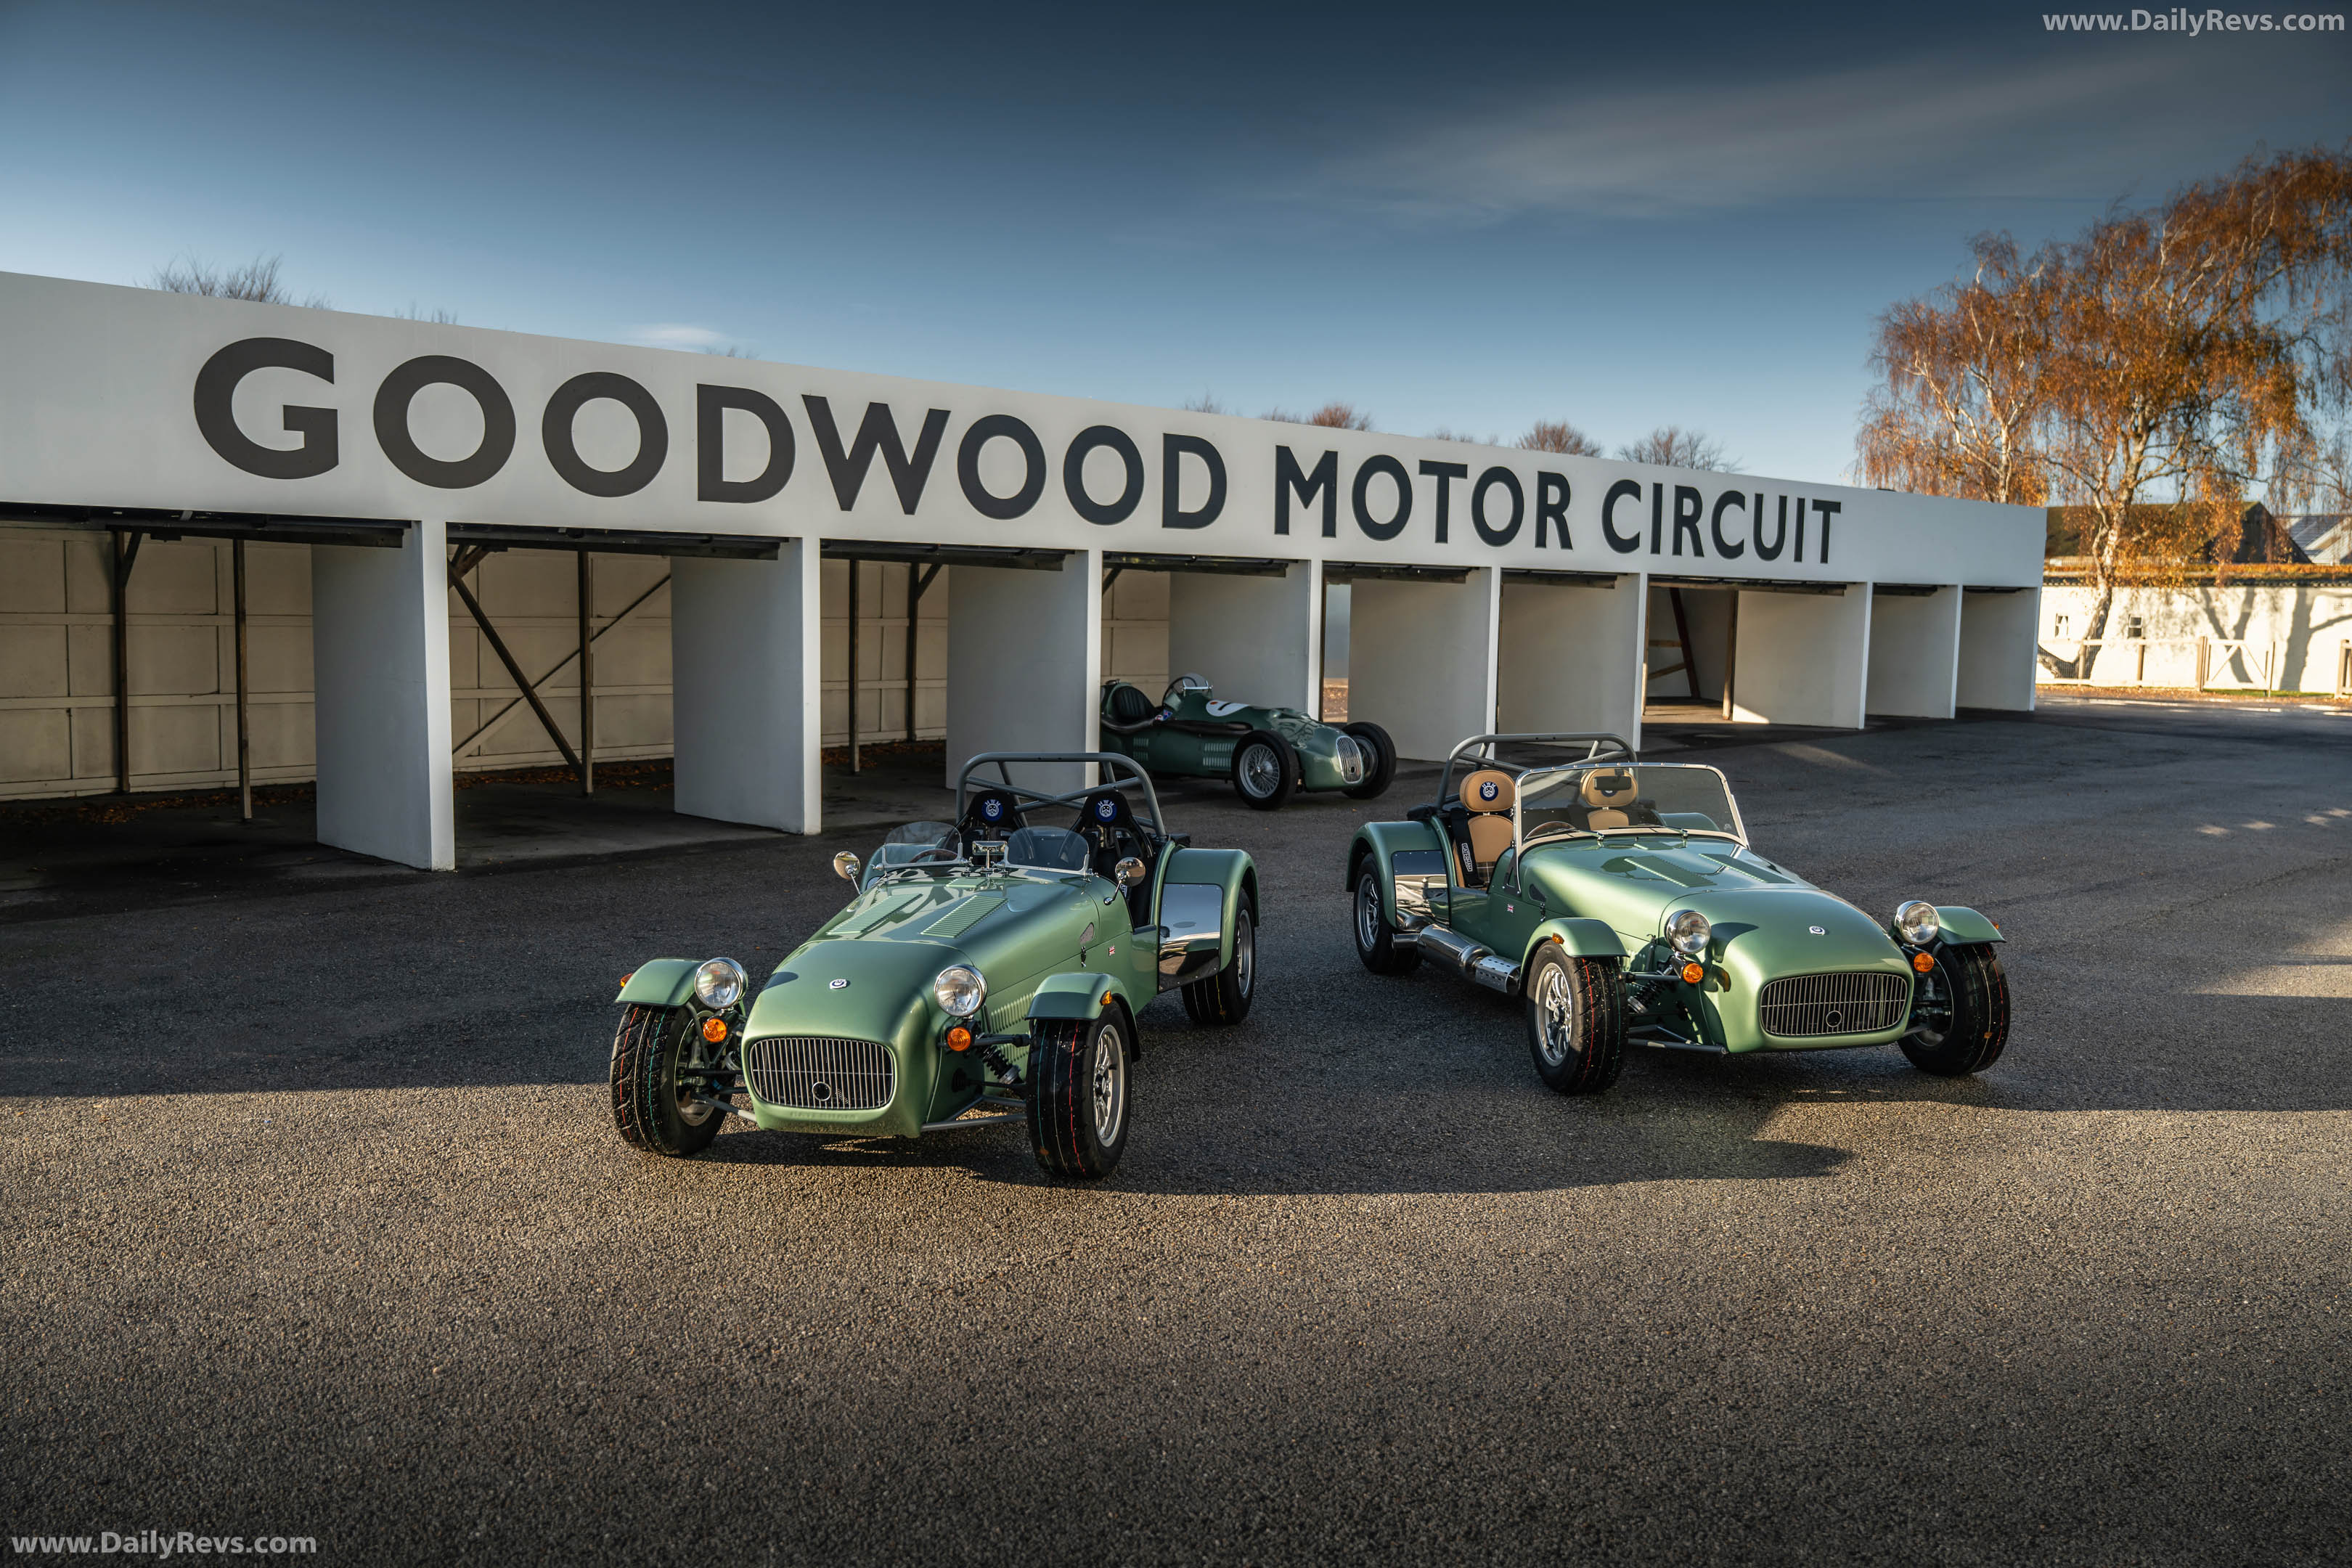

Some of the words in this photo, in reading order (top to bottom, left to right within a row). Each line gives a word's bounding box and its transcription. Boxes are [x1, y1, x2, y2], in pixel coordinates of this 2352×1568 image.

[193, 337, 1228, 529] GOODWOOD
[1274, 445, 1574, 550] MOTOR
[1601, 479, 1842, 563] CIRCUIT
[1462, 844, 1472, 870] CATERHAM
